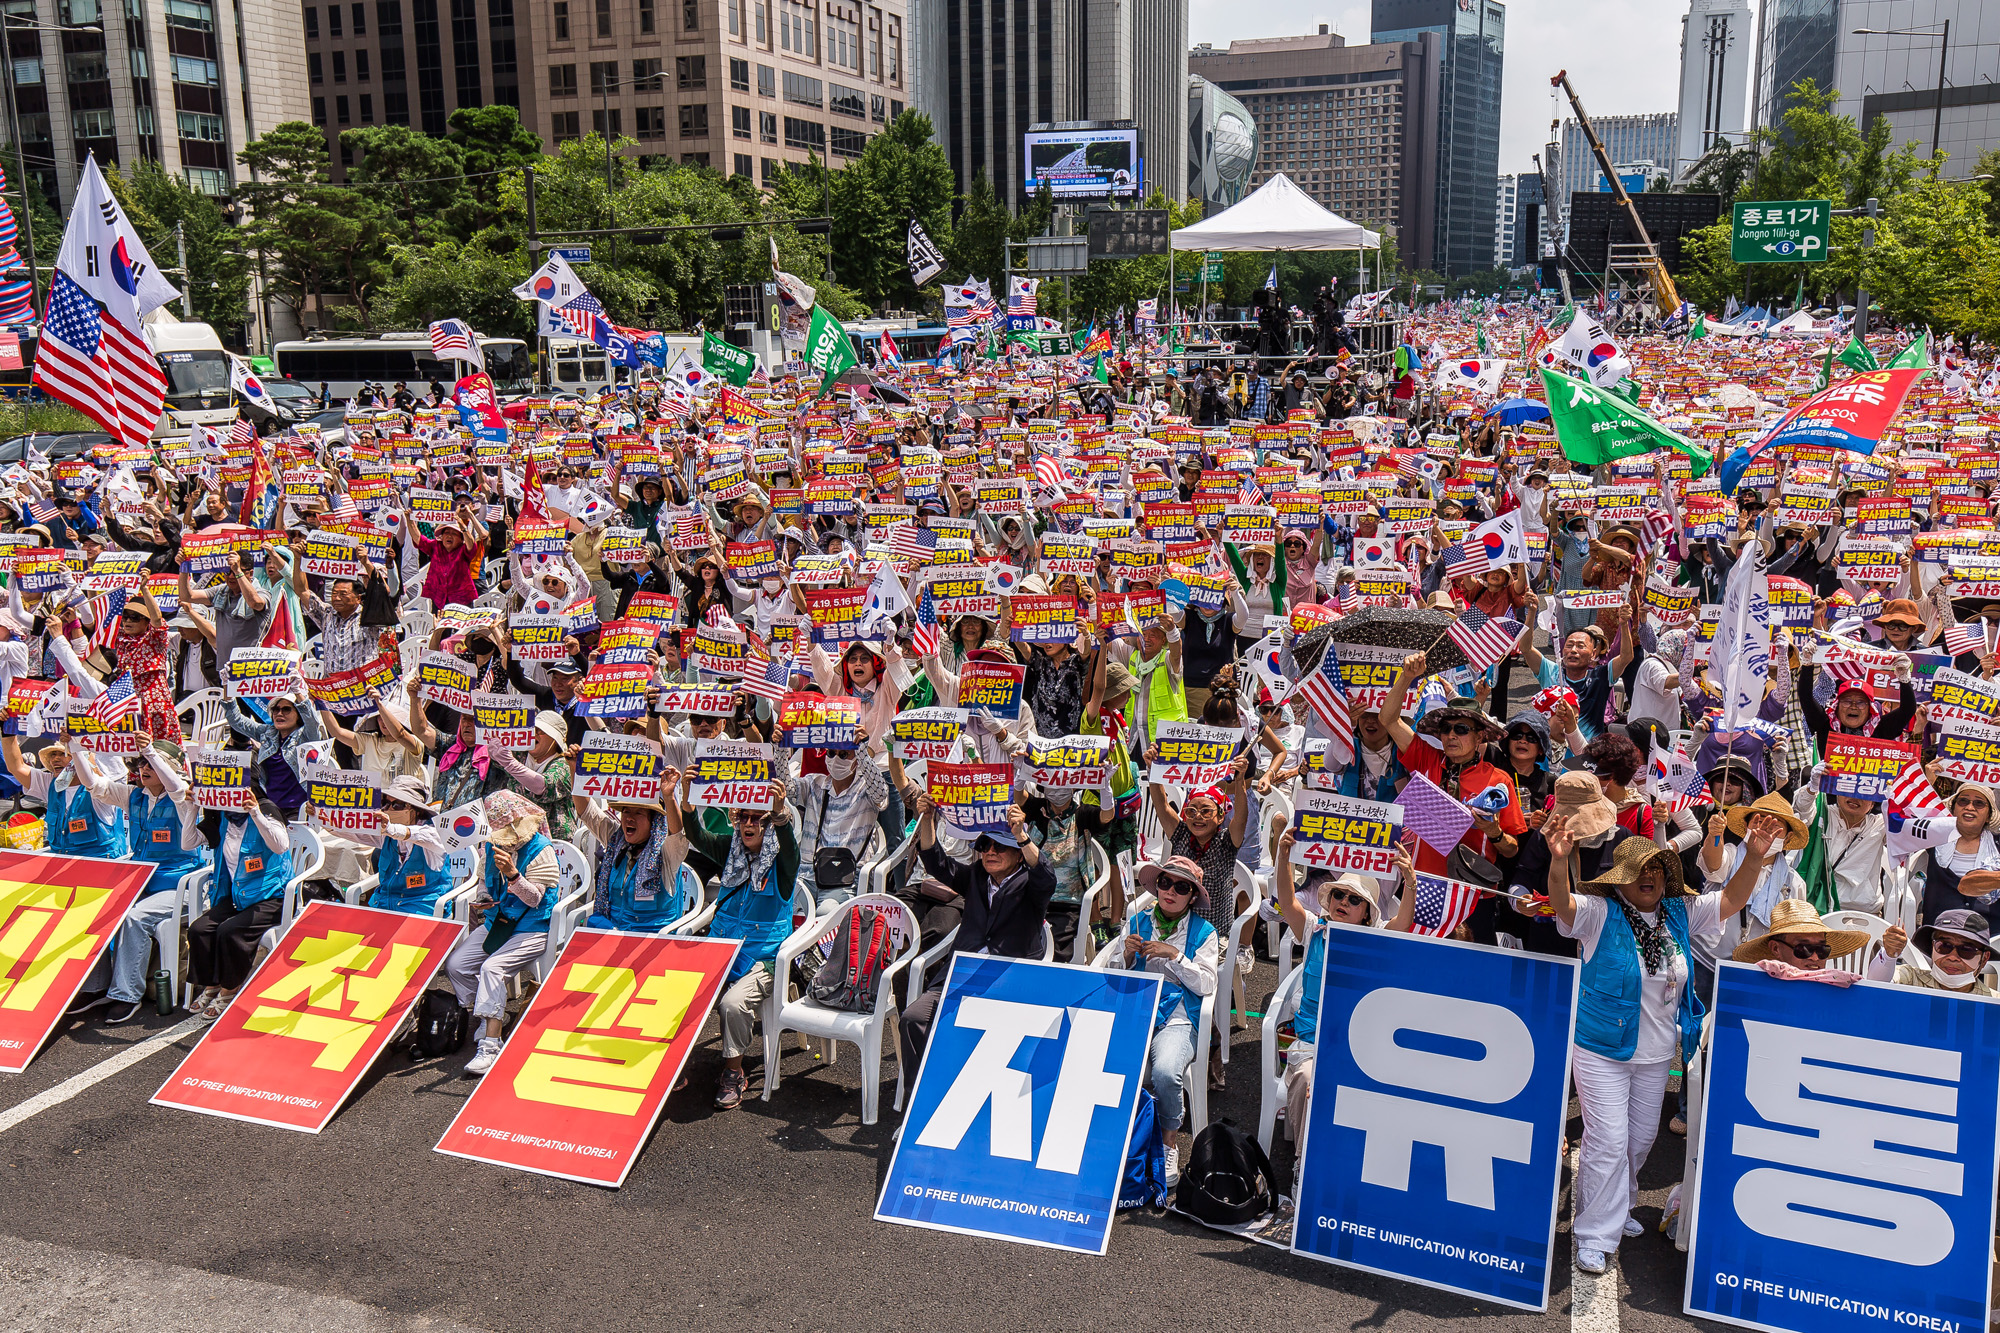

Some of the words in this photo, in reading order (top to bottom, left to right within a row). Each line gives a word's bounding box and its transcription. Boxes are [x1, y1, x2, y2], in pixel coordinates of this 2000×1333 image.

[1741, 207, 1819, 226] 종로1가
[1740, 229, 1769, 240] Jongno
[1773, 228, 1800, 240] 1(il)-ga
[1782, 243, 1789, 252] 6
[765, 283, 777, 295] 현재
[771, 304, 780, 331] 8
[1012, 319, 1033, 331] 연천
[709, 340, 748, 367] 자유마을
[725, 399, 743, 411] 4.10
[708, 471, 745, 491] 부정선거
[808, 489, 853, 501] 주사파척결
[979, 488, 1018, 500] 부정선거
[1323, 489, 1365, 501] 부정선거
[1597, 495, 1642, 507] 부정선거
[411, 498, 452, 510] 부정선거
[813, 501, 854, 513] 끝장내자
[983, 501, 1022, 513] 수사하라
[1273, 503, 1319, 514] 주사파척결
[1326, 501, 1368, 514] 수사하라
[1783, 496, 1830, 510] 부정선거
[415, 510, 456, 522] 수사하라
[1145, 515, 1195, 527] 주사파척결
[1278, 513, 1319, 525] 끝장내자
[1388, 507, 1432, 519] 부정선거
[1600, 507, 1645, 520] 수사하라
[1785, 509, 1834, 523] 수사하라
[1858, 507, 1911, 520] 주사파척결
[1226, 515, 1272, 528] 부정선거
[1390, 519, 1433, 532] 수사하라
[1864, 518, 1911, 531] 끝장내자
[516, 527, 568, 540] 주사파척결
[1152, 526, 1196, 538] 끝장내자
[1228, 529, 1275, 542] 수사하라
[305, 542, 353, 561] 부정선거
[522, 540, 566, 553] 끝장내자
[1043, 544, 1093, 558] 부정선거
[728, 549, 775, 566] 주사파척결
[1113, 551, 1158, 566] 부정선거
[1843, 551, 1896, 565] 부정선거
[90, 561, 139, 574] 부정선거
[306, 559, 358, 576] 수사하라
[1046, 560, 1097, 574] 수사하라
[1845, 566, 1900, 580] 수사하라
[88, 575, 141, 591] 수사하라
[794, 570, 842, 582] 수사하라
[938, 598, 998, 614] 수사하라
[1571, 594, 1622, 607] 수사하라
[1645, 591, 1693, 611] 부정선거
[1014, 608, 1076, 624] 주사파척결
[513, 627, 564, 643] 부정선거
[1022, 623, 1078, 640] 끝장내자
[600, 633, 654, 648] 주사파척결
[693, 636, 742, 658] 부정선거
[518, 644, 569, 659] 수사하라
[604, 647, 650, 664] 끝장내자
[230, 660, 291, 678] 부정선거
[420, 667, 470, 692] 부정선거
[960, 678, 976, 690] 4.10
[976, 679, 1014, 690] 부정선거
[583, 678, 648, 698] 주사파척결
[587, 696, 646, 714] 끝장내자
[664, 692, 735, 712] 수사하라
[959, 690, 1012, 706] 수사하라!
[1932, 684, 1999, 715] 부정선거
[476, 707, 528, 728] 부정선거
[782, 709, 858, 726] 주사파척결
[792, 726, 856, 743] 끝장내자
[895, 722, 960, 740] 부정선거
[1166, 728, 1203, 740] 대한민국
[1954, 724, 1991, 739] 대한민국
[1029, 747, 1100, 768] 부정선거
[1158, 741, 1236, 764] 부정선거
[1858, 747, 1881, 757] 5.16
[581, 752, 656, 774] 부정선거
[698, 760, 768, 780] 부정선거
[194, 768, 243, 786] 부정선거
[1032, 768, 1106, 786] 수사하라
[1162, 764, 1233, 784] 수사하라
[310, 784, 373, 808] 부정선거
[582, 777, 660, 800] 수사하라
[701, 783, 773, 804] 수사하라
[931, 783, 1010, 805] 주사파척결
[1309, 798, 1349, 814] 대한민국
[1351, 803, 1388, 820] 무너졌다
[318, 809, 380, 830] 수사하라
[1300, 813, 1393, 846] 부정선거
[1302, 842, 1394, 874] 수사하라
[241, 930, 433, 1072] 척
[0, 1039, 24, 1050] REA!
[513, 963, 705, 1116] 결
[183, 1076, 200, 1088] GO
[199, 1079, 226, 1094] FREE
[224, 1084, 284, 1105] UNIFICATION
[283, 1095, 323, 1110] KOREA!
[915, 995, 1126, 1175] 자
[1333, 987, 1535, 1210] 유
[465, 1125, 483, 1136] GO
[481, 1128, 511, 1141] FREE
[510, 1133, 577, 1153] UNIFICATION
[575, 1144, 618, 1160] KOREA!
[1732, 1019, 1965, 1266] 통
[903, 1184, 924, 1197] GO
[925, 1188, 958, 1204] FREE
[960, 1193, 1038, 1216] UNIFICATION
[1040, 1206, 1091, 1225] KOREA!
[1317, 1215, 1338, 1230] GO
[1340, 1221, 1376, 1240] FREE
[1379, 1229, 1465, 1261] UNIFICATION
[1468, 1250, 1525, 1274] KOREA!
[1715, 1272, 1739, 1288] GO
[1743, 1277, 1784, 1298] FREE
[1788, 1288, 1890, 1321] UNIFICATION
[1894, 1310, 1960, 1333] KOREA!
